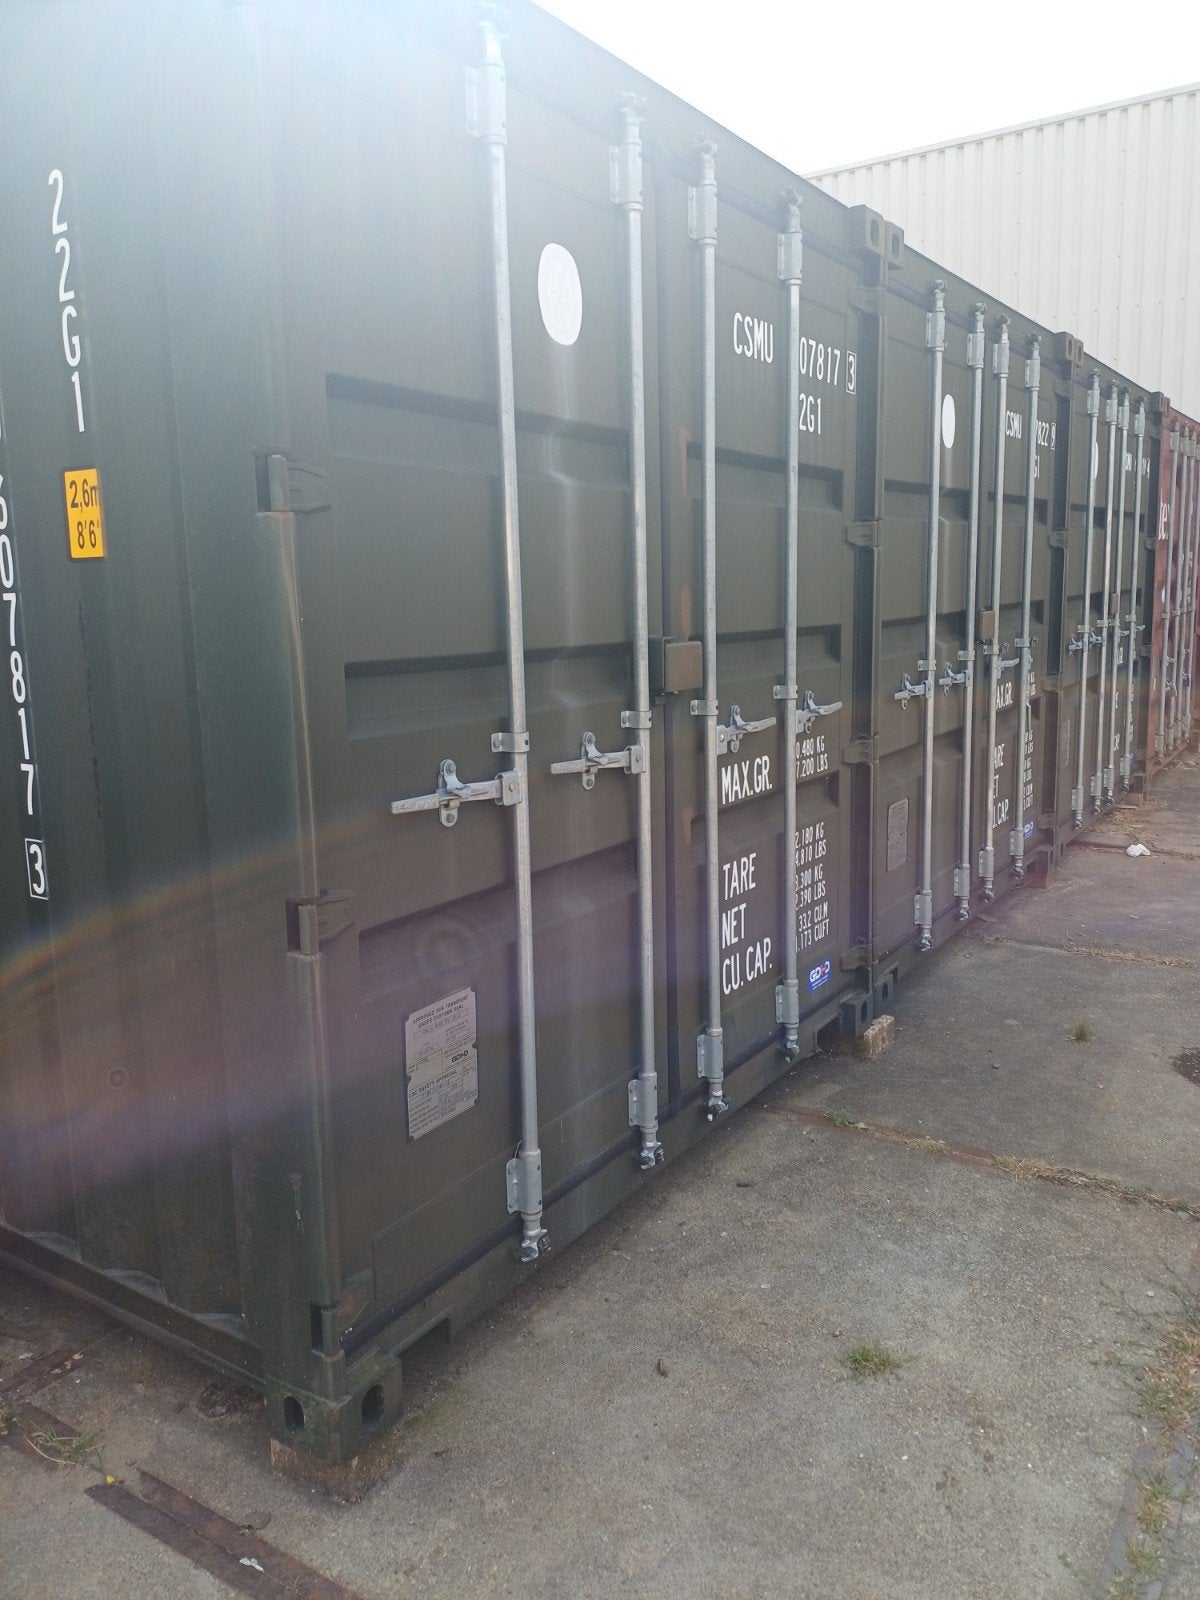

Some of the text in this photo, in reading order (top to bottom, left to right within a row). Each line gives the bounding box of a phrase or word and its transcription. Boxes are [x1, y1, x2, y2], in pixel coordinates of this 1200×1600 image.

[47, 167, 86, 433] 22G1
[733, 312, 857, 393] CSMU 07817 3
[1005, 410, 1023, 439] CSMU
[816, 734, 825, 753] KG
[816, 753, 829, 772] LBS
[815, 821, 825, 841] KG
[814, 839, 827, 859] LBS
[28, 842, 47, 899] 3
[722, 852, 757, 900] TARE
[814, 863, 824, 882] KG
[813, 880, 826, 900] LBS
[722, 903, 747, 950] NET
